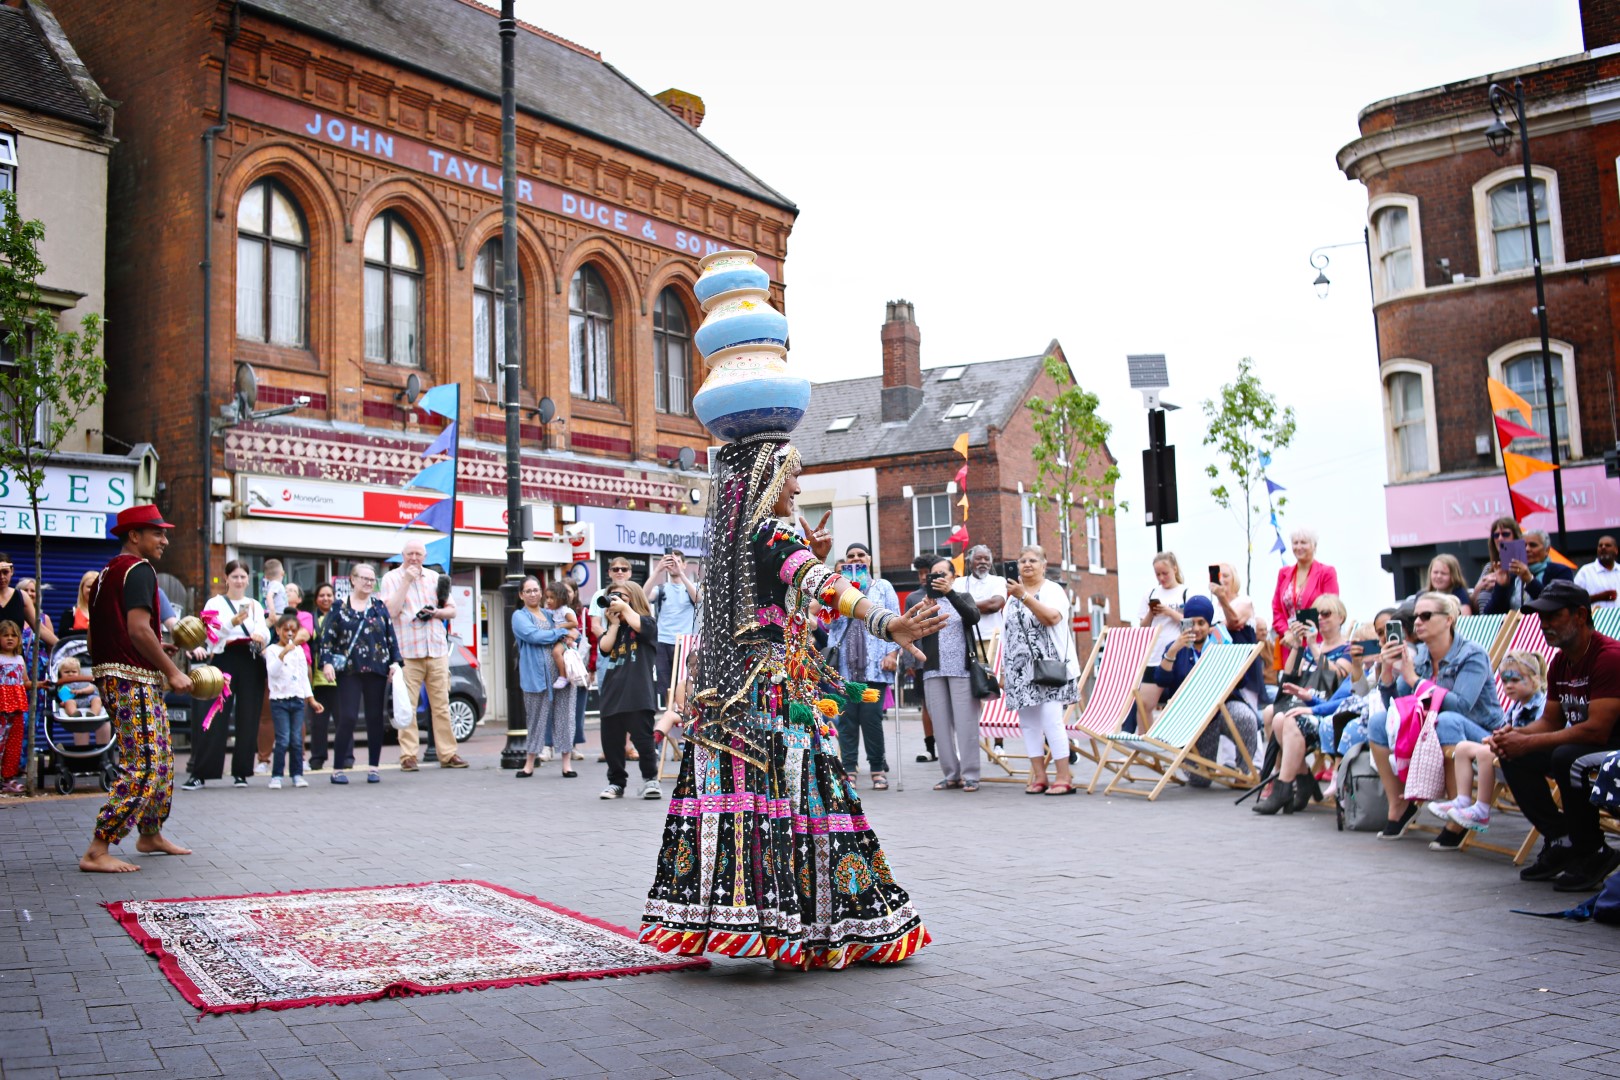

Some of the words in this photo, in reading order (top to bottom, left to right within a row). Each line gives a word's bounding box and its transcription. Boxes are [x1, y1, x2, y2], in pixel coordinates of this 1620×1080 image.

[305, 113, 394, 158] JOHN
[428, 149, 533, 202] TAYLR
[562, 193, 629, 231] DUCE
[642, 220, 657, 241] &
[675, 231, 730, 255] SON
[293, 493, 334, 504] MoneyGram
[398, 500, 430, 511] Wednesbu
[1451, 497, 1506, 516] NAIL
[1535, 489, 1588, 510] OOM
[399, 510, 413, 520] Post
[615, 524, 636, 544] The
